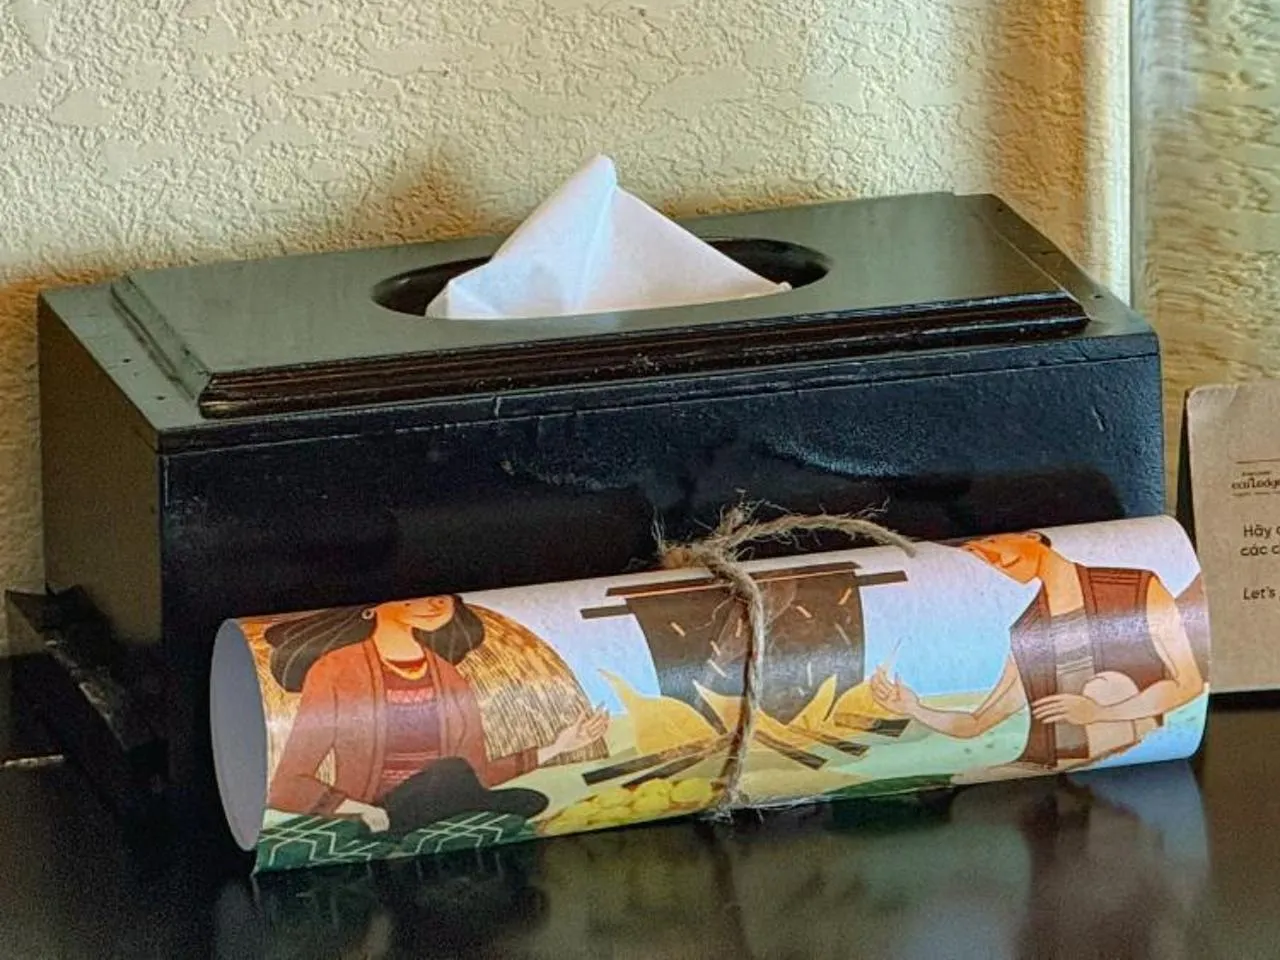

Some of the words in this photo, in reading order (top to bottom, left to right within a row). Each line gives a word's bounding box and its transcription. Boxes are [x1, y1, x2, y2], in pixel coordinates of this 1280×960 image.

[1243, 524, 1272, 539] Hãy
[1240, 543, 1269, 556] các
[1243, 587, 1275, 600] Let's
